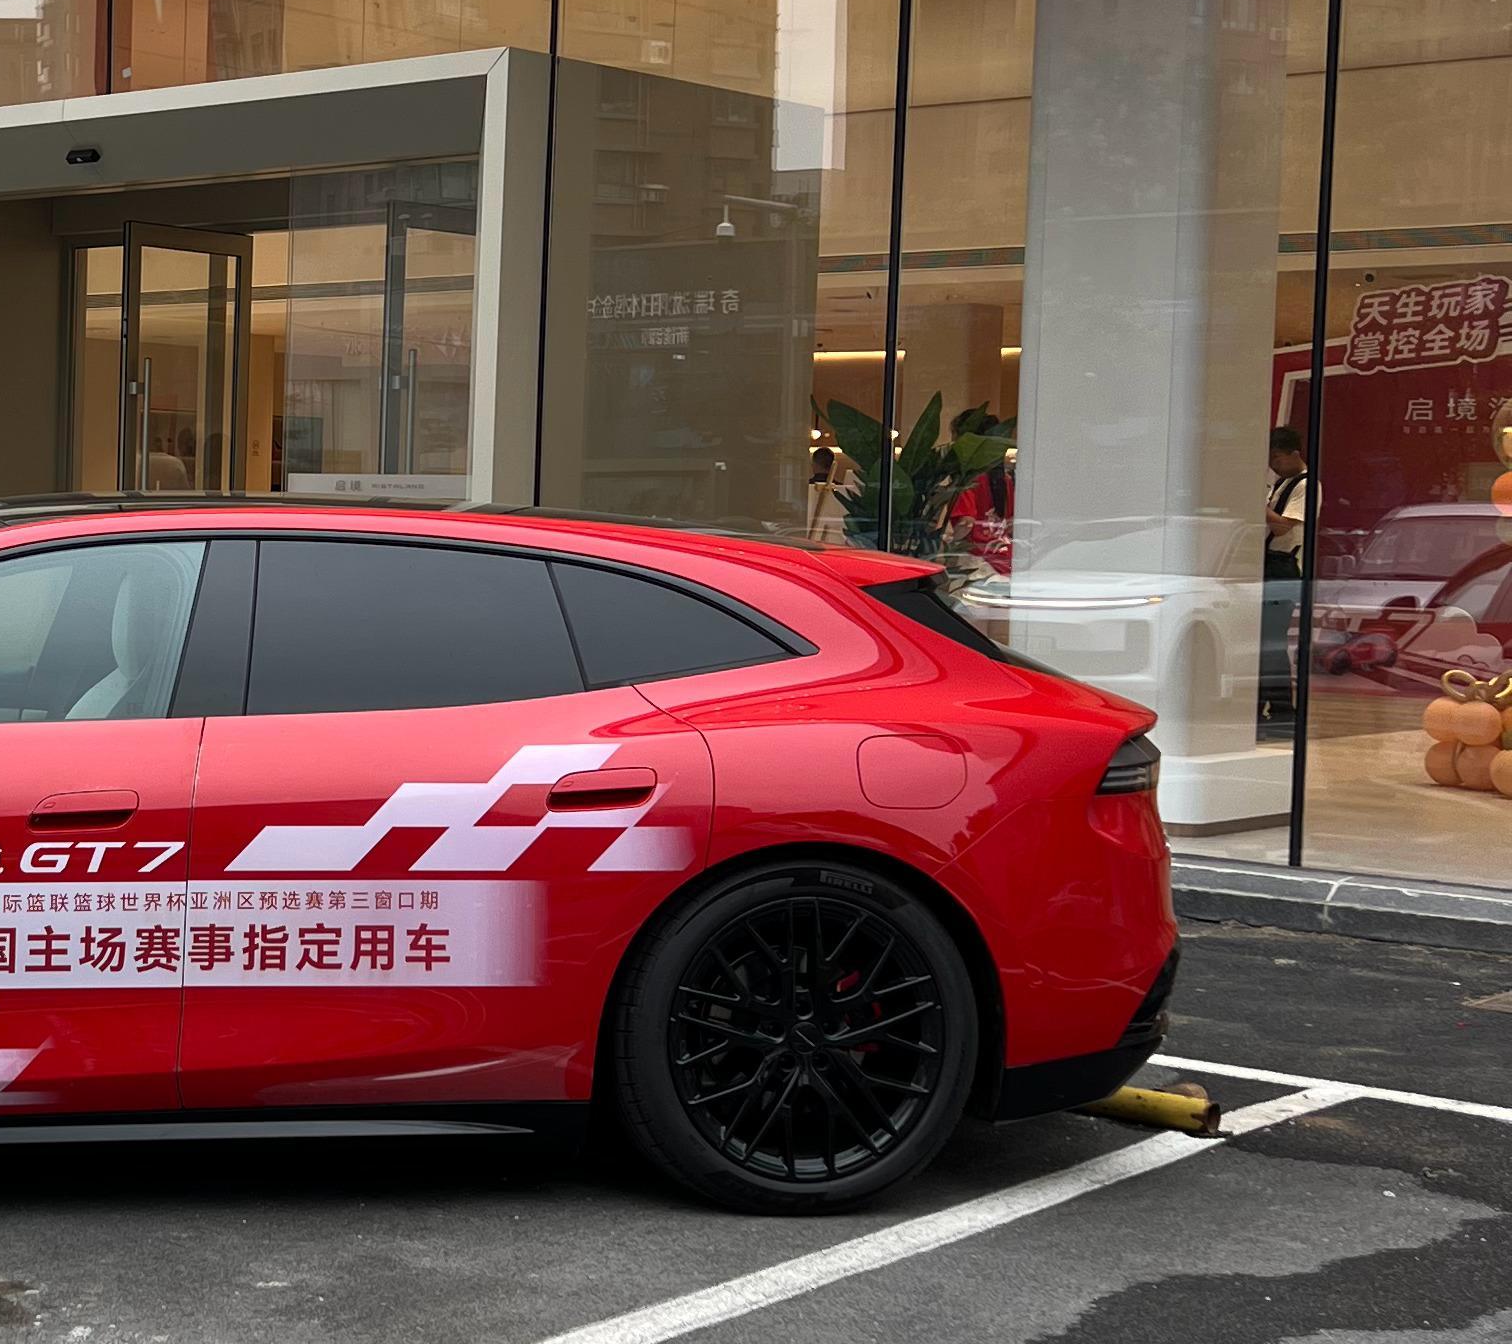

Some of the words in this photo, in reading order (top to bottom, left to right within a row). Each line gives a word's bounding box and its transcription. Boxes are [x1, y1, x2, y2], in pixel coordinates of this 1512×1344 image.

[1357, 281, 1500, 328] 天生玩家
[1350, 319, 1490, 364] 掌控全场
[20, 842, 185, 873] GT7
